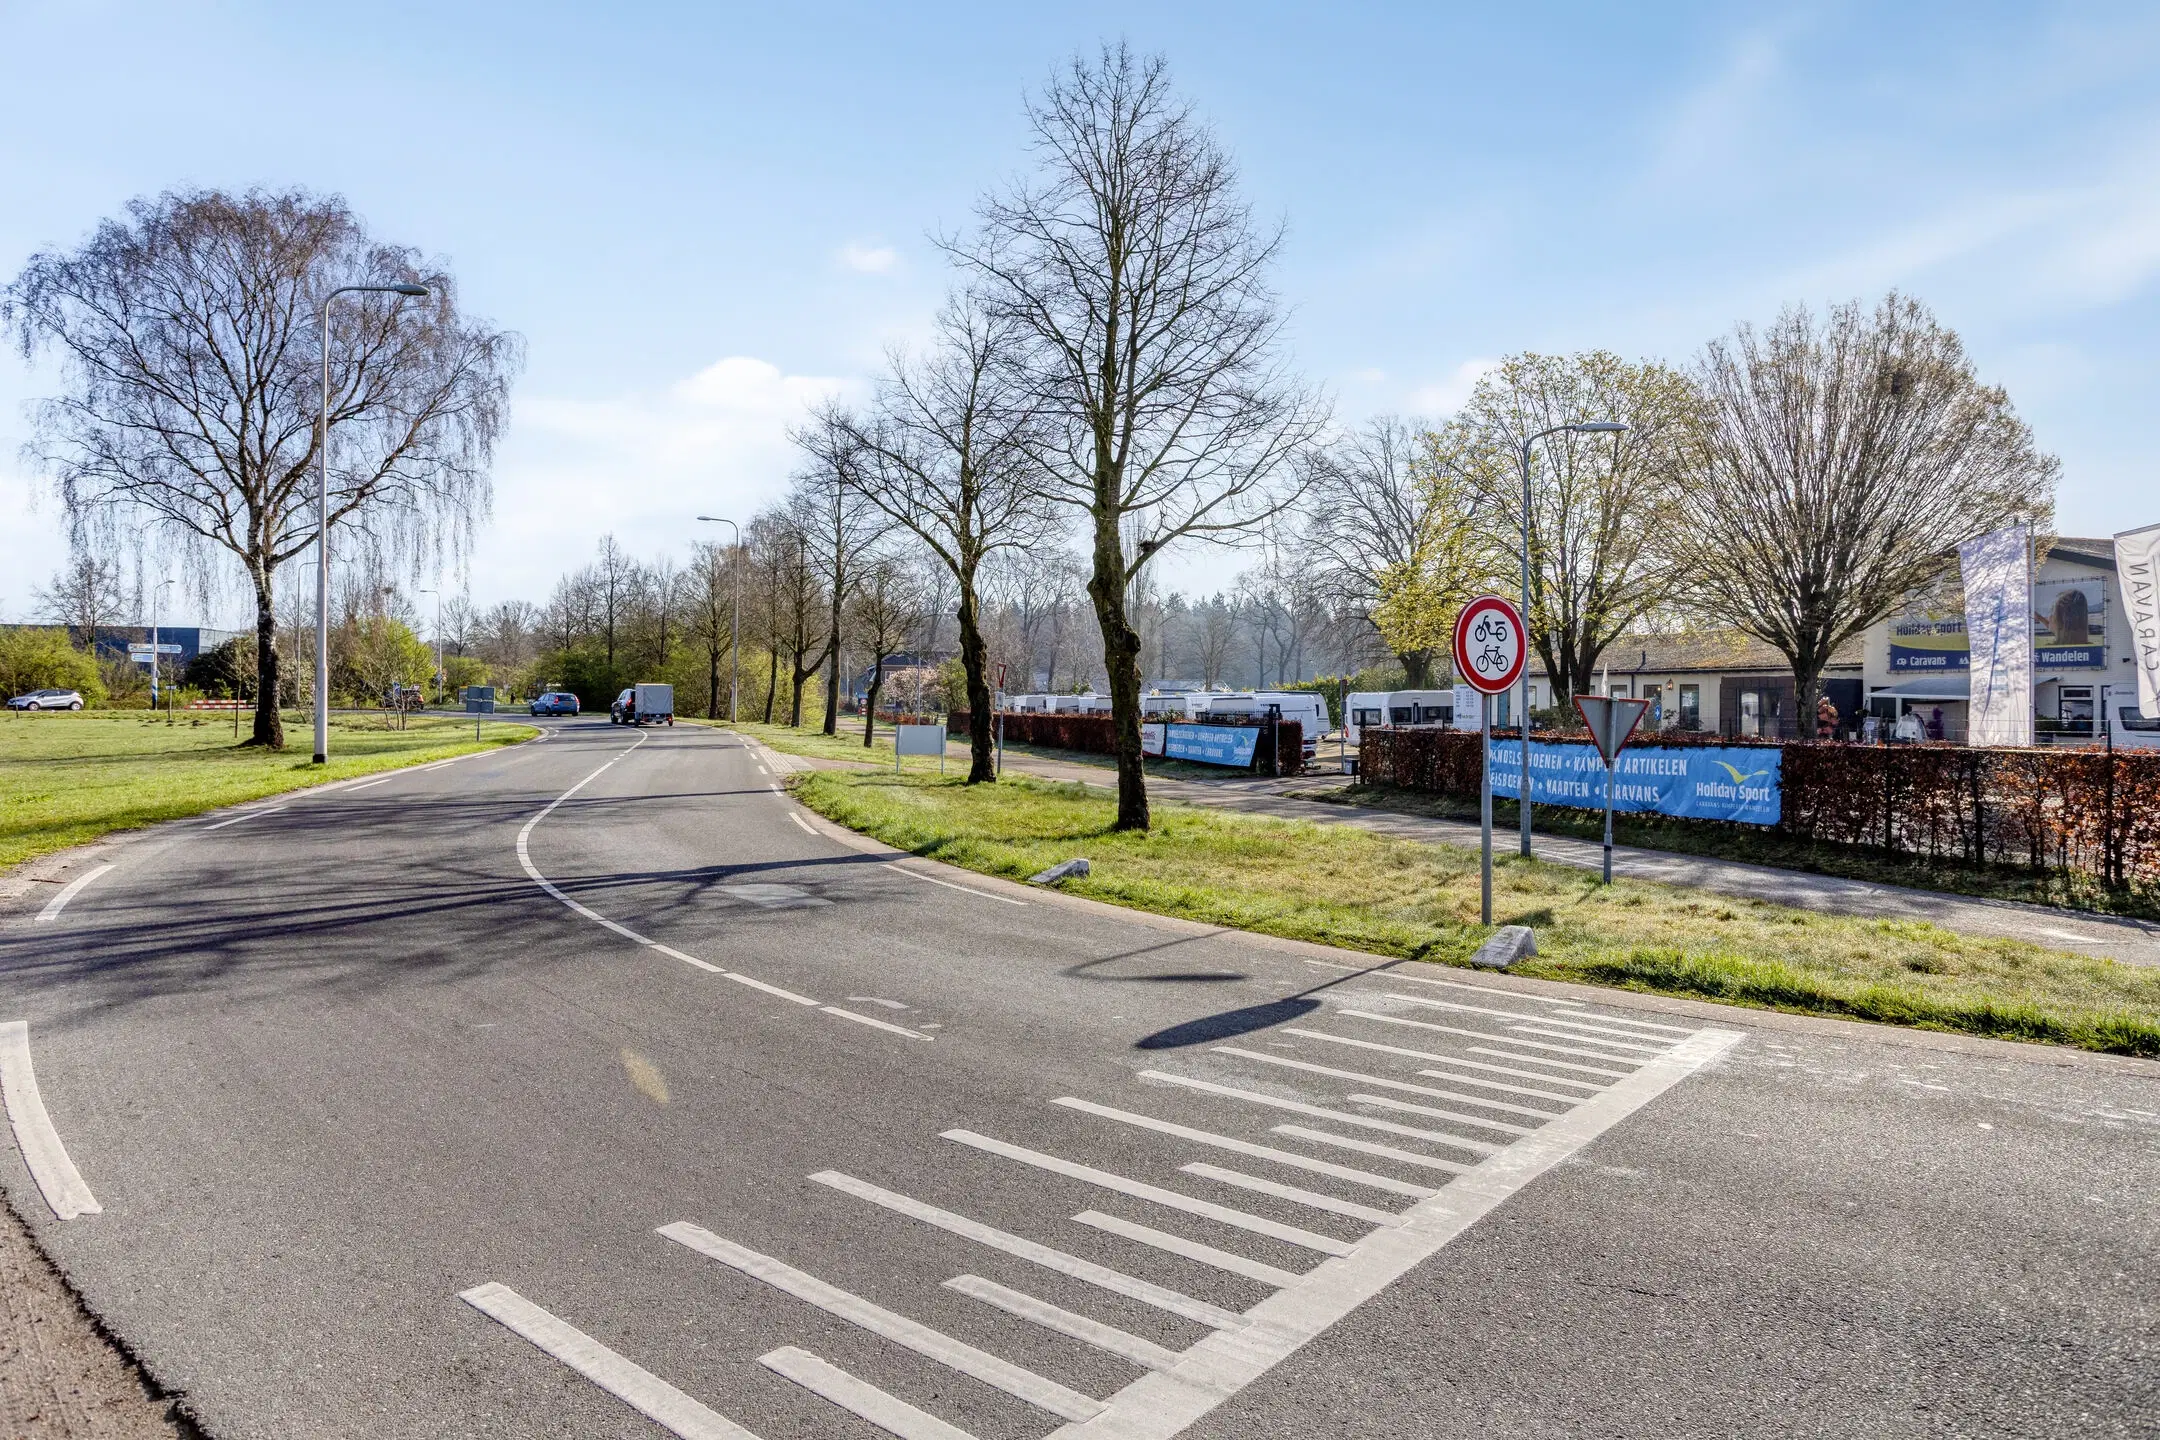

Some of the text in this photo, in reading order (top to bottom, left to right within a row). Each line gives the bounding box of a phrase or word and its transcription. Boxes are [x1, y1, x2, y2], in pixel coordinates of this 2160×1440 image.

[1934, 622, 1962, 636] Sport
[1910, 656, 1947, 666] Caravans
[2041, 651, 2090, 663] Wandelen
[1489, 748, 1687, 776] ANDELSHOENEN KAMPR ARTIKELEN
[1489, 772, 1661, 802] EISBOEKN KAARTEN CRAVANS
[1696, 782, 1770, 803] Holiday Sport
